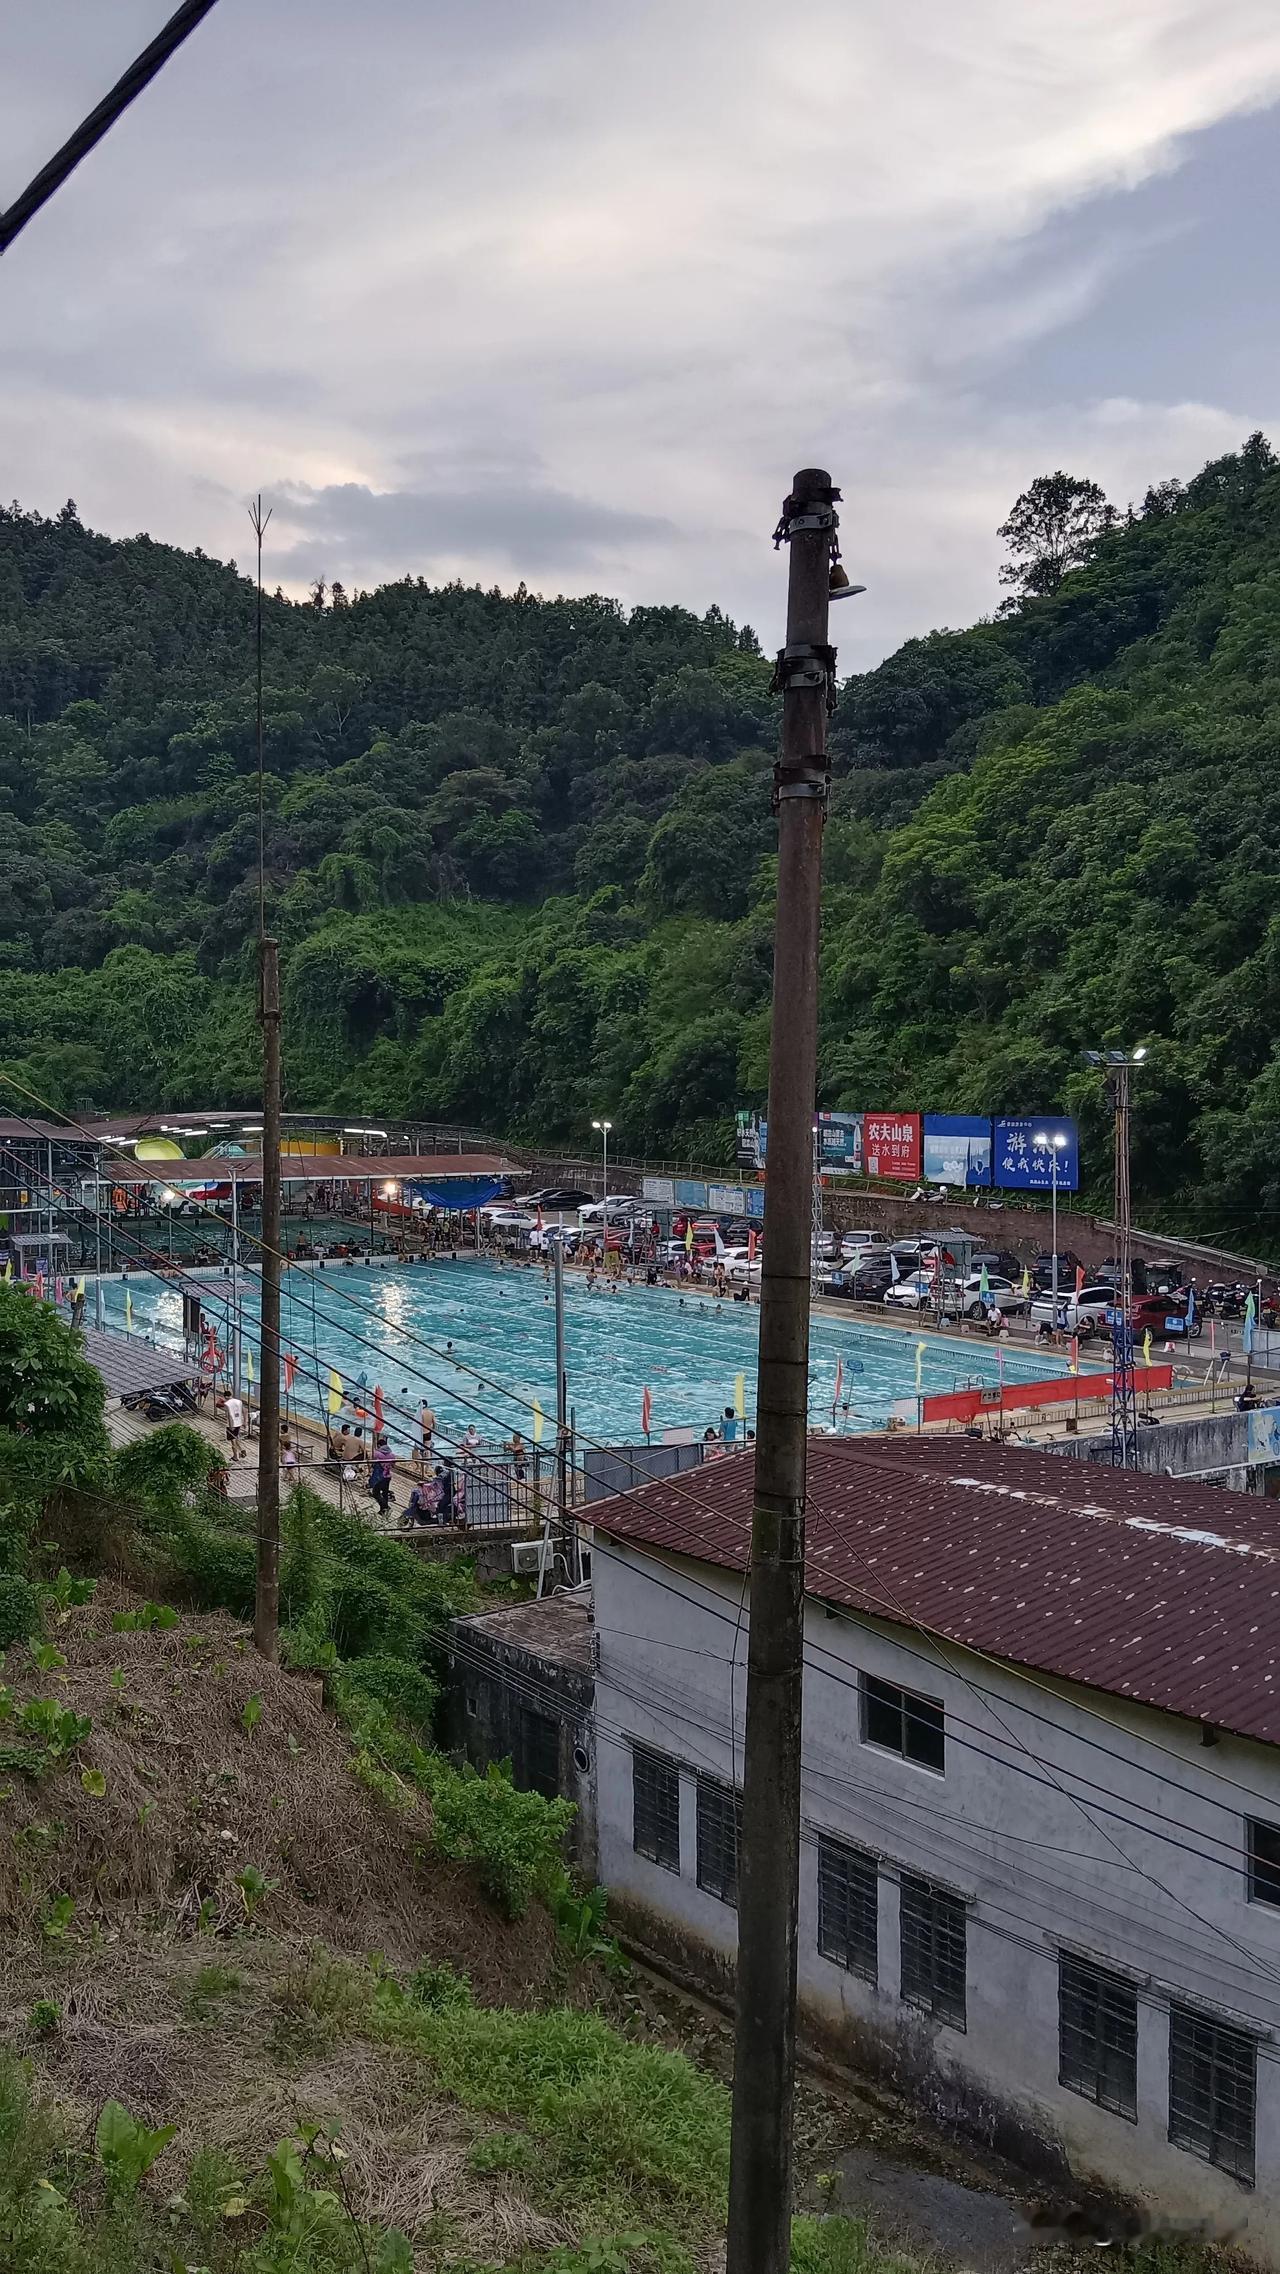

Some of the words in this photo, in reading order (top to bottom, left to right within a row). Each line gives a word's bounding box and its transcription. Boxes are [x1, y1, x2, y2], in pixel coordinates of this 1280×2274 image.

[868, 1122, 913, 1143] 农夫山泉
[871, 1143, 910, 1158] 送水到府
